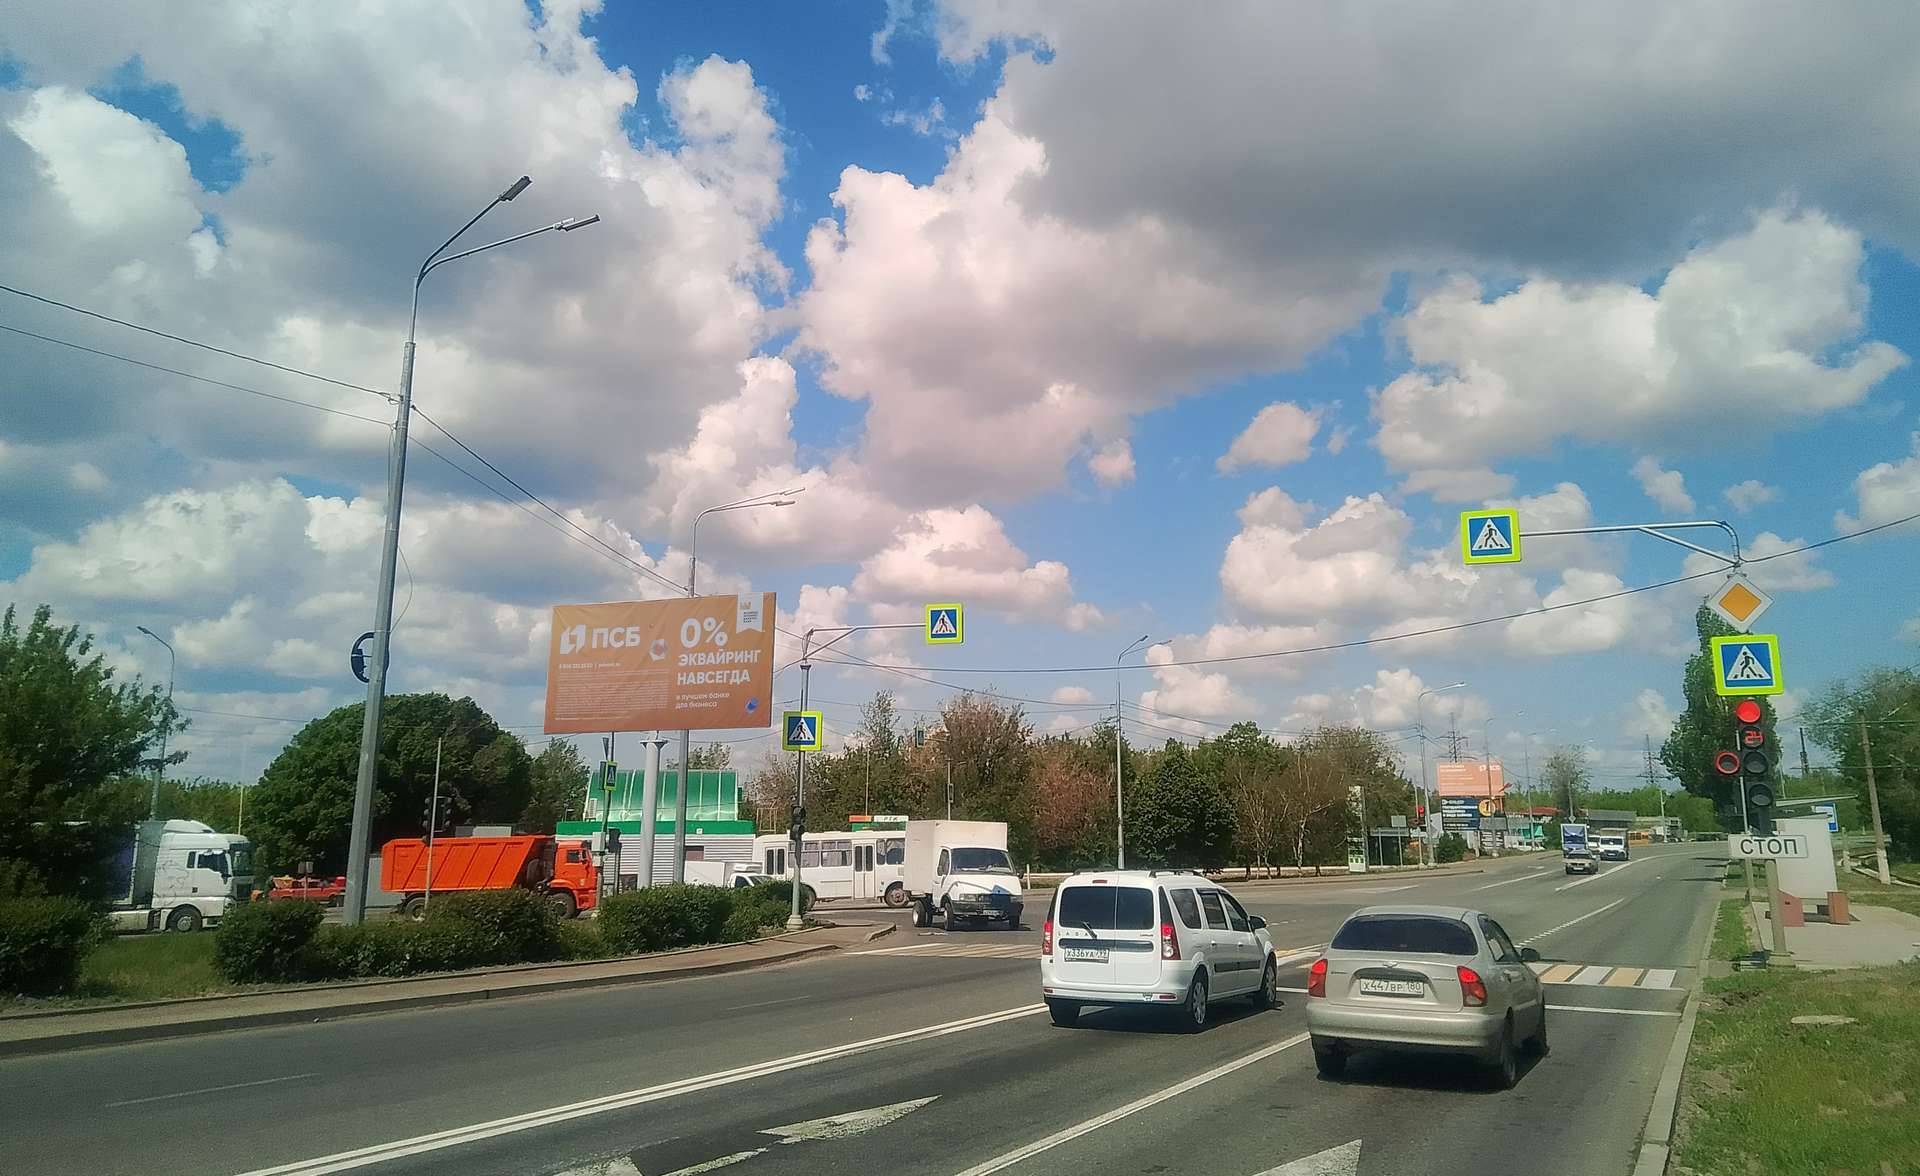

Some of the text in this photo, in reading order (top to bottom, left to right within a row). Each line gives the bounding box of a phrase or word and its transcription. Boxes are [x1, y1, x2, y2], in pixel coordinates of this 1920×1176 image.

[591, 626, 641, 649] ПСБ
[680, 616, 729, 649] 0%
[678, 649, 762, 667] ЭКВАЙРИНГ
[676, 669, 751, 686] НАВСЕГДА
[1740, 838, 1798, 855] СТОП
